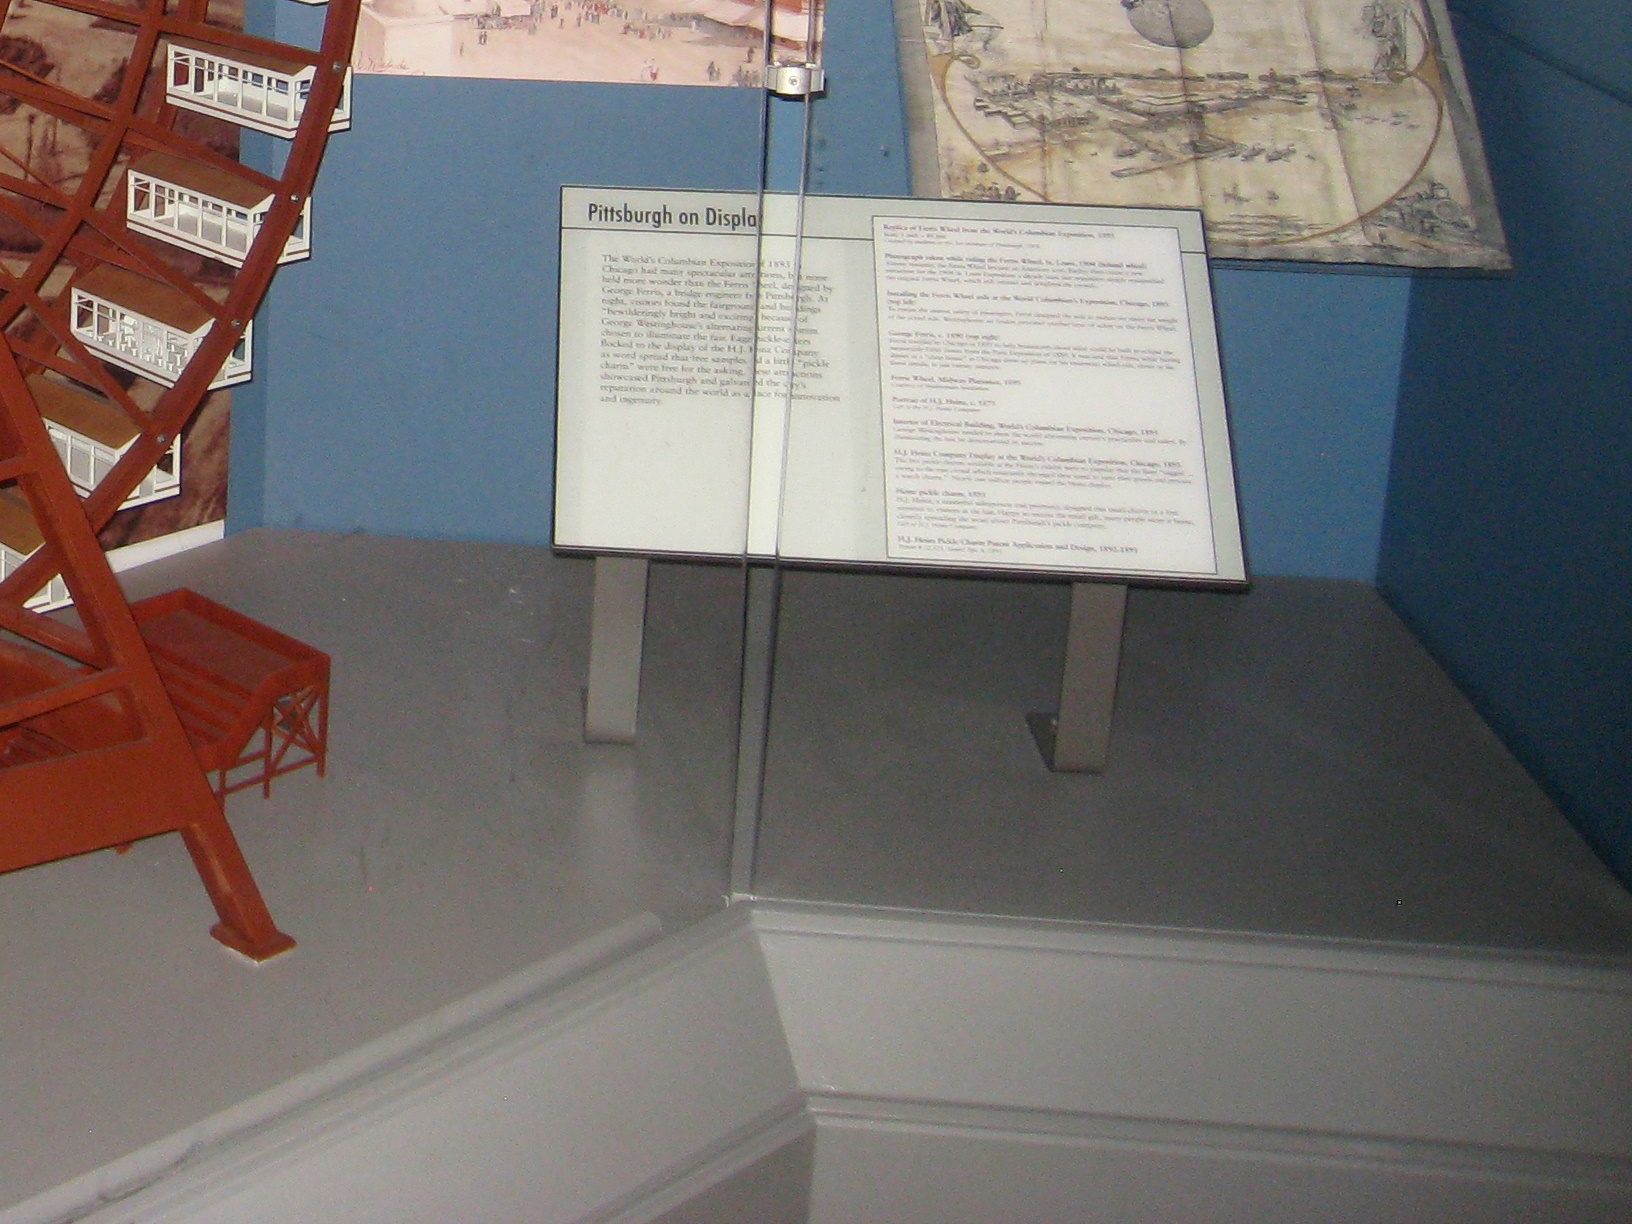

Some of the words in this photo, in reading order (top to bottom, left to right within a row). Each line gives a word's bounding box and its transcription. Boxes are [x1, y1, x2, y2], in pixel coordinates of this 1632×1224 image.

[588, 202, 672, 228] Pittsburgh
[679, 211, 699, 225] on
[705, 207, 762, 231] Displa
